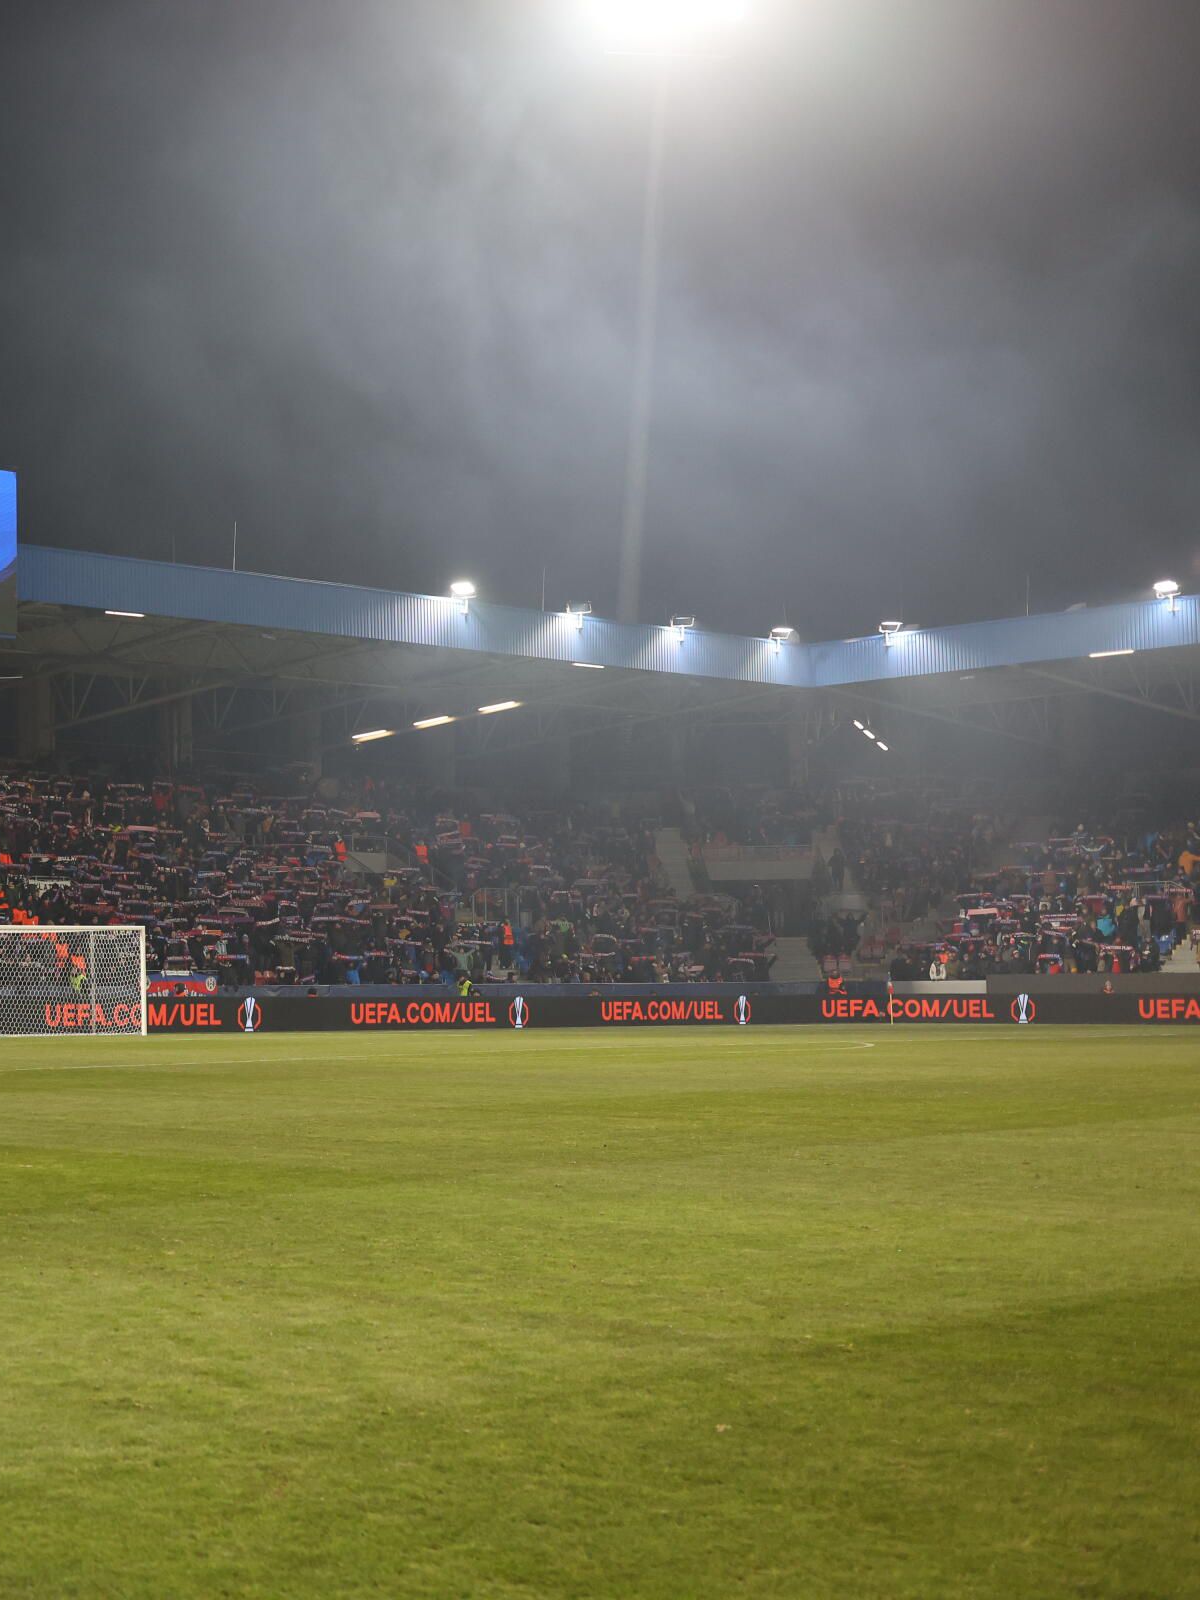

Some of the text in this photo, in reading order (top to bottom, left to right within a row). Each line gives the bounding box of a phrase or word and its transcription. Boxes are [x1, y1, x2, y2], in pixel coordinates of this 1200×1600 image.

[351, 1003, 496, 1024] UEFA.COM/UEL
[601, 1001, 723, 1022] UEFA.COM/UEL
[822, 1000, 994, 1018] UEFA.COM/UEL
[1139, 999, 1200, 1020] UEFA
